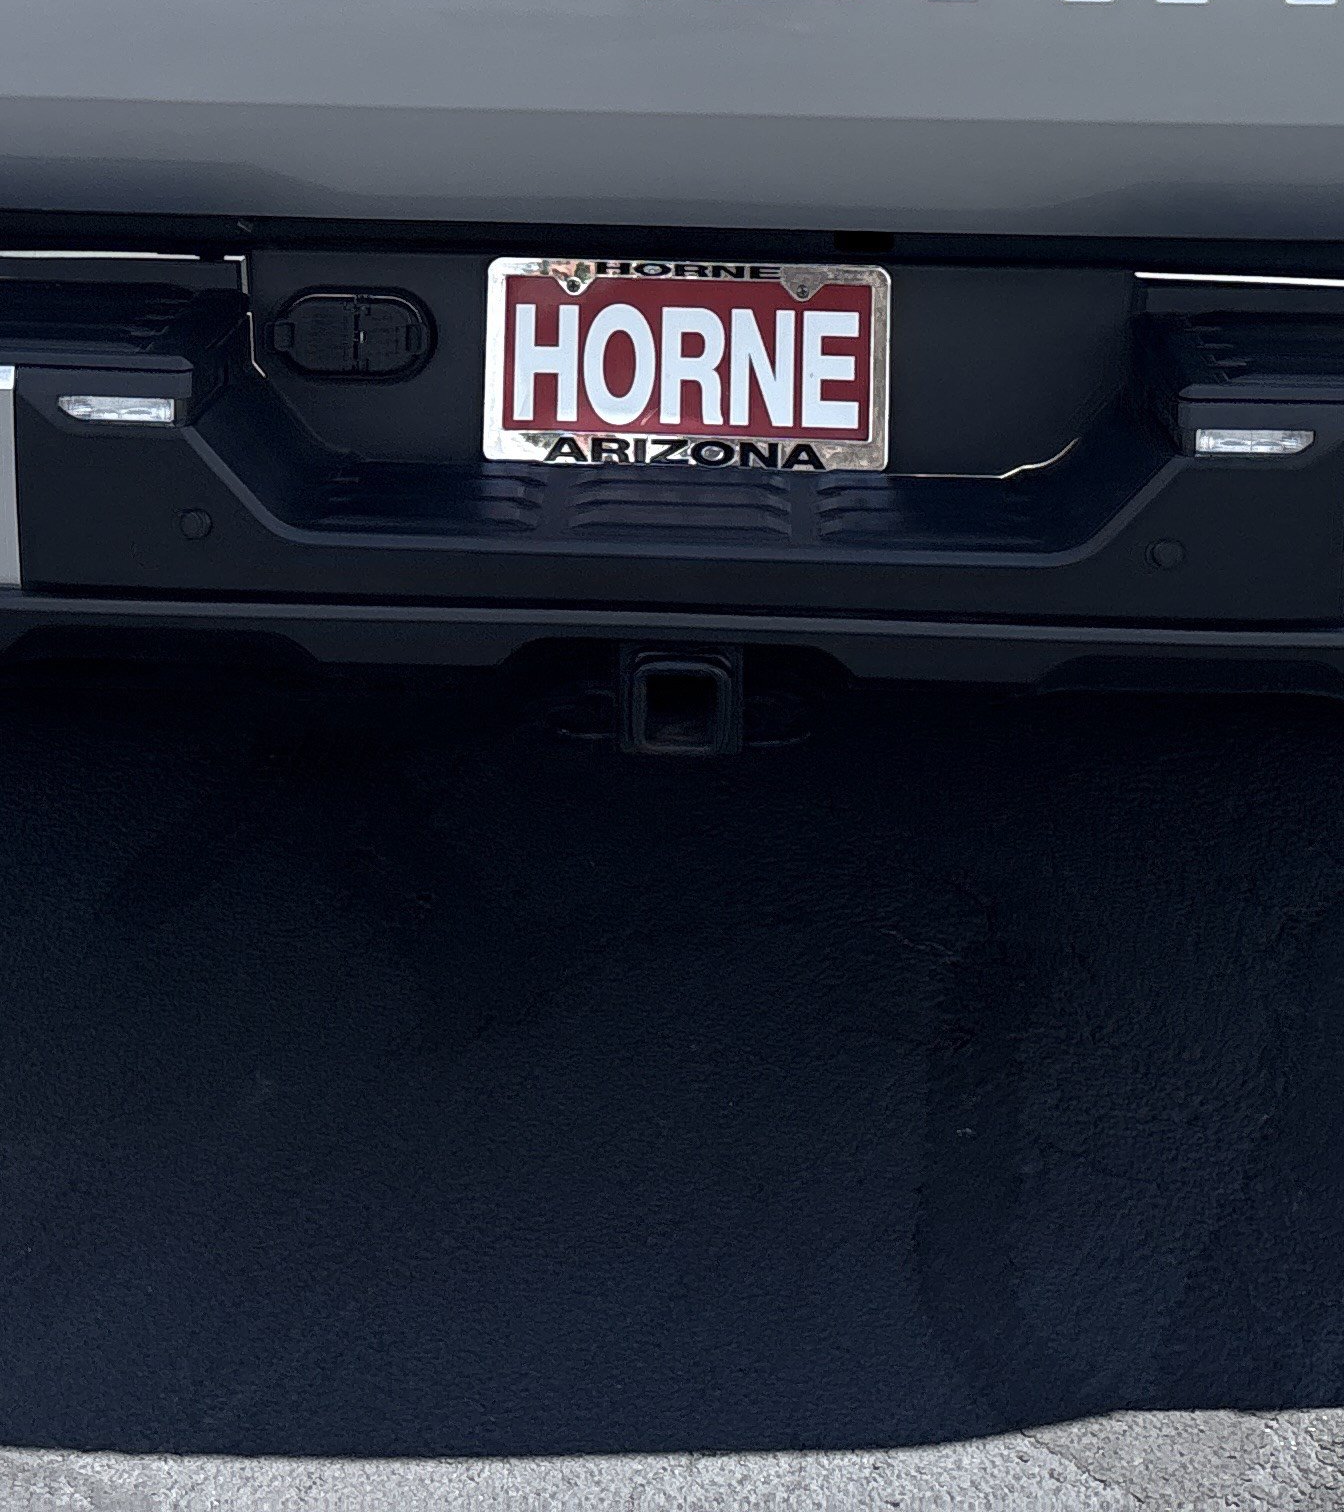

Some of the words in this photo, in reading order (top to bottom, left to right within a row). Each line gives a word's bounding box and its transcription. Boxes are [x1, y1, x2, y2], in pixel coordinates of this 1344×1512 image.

[597, 261, 781, 279] HORNE
[513, 303, 860, 429] HORNE
[544, 436, 826, 470] ARIZONA
